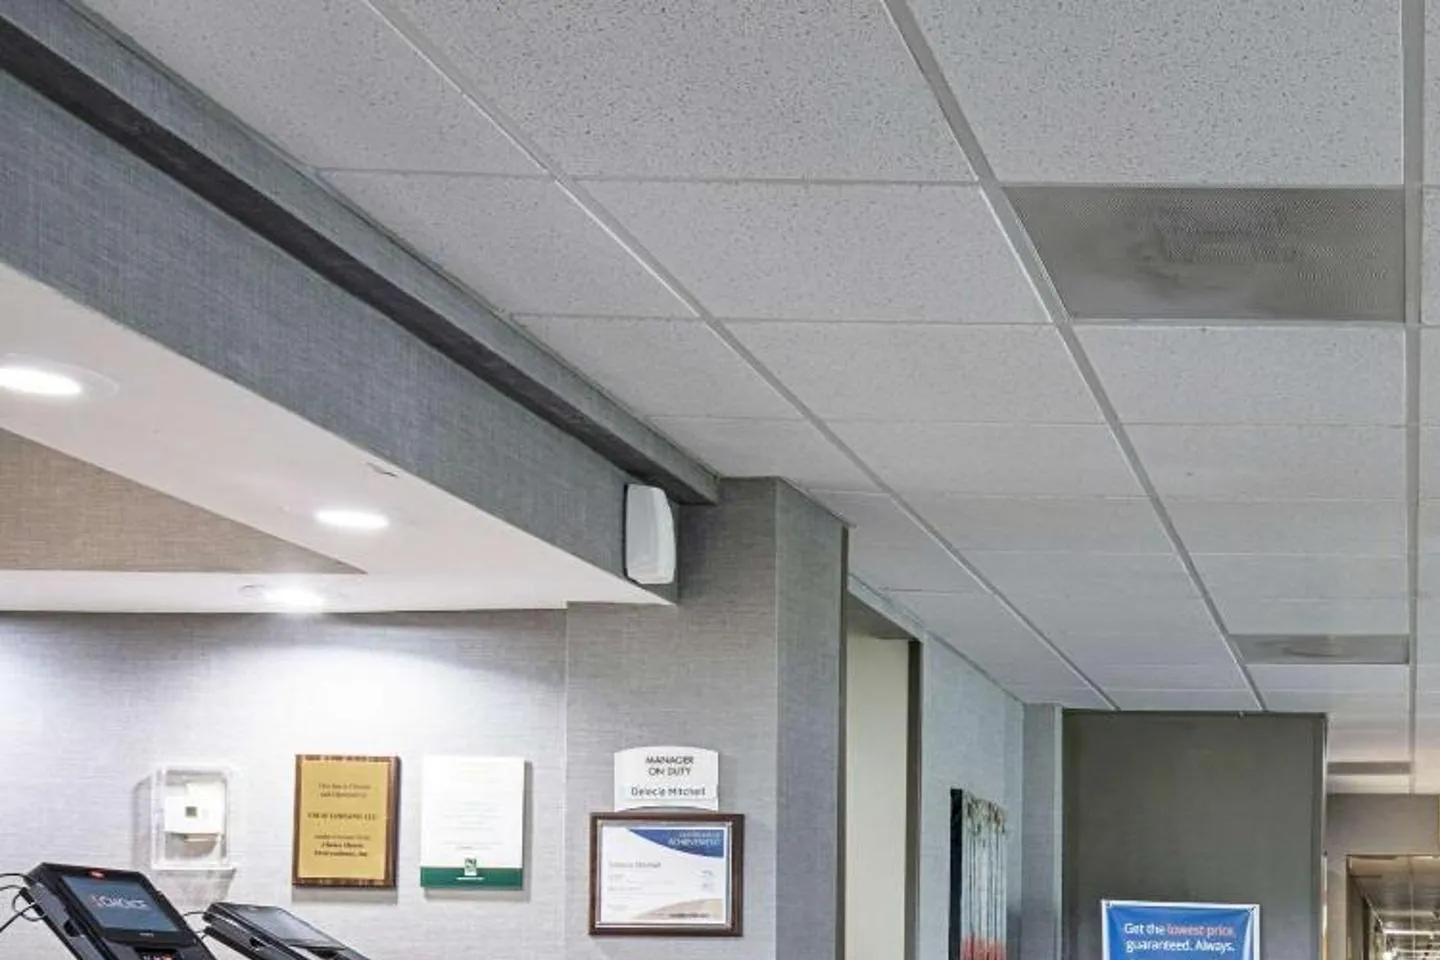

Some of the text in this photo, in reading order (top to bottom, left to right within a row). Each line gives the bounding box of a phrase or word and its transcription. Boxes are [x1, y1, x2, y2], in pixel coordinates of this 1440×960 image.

[645, 756, 695, 764] MANAGER
[648, 767, 691, 776] ON DUTY
[1124, 923, 1144, 934] Get
[1146, 923, 1165, 935] the
[1167, 924, 1205, 936] lowest
[1126, 939, 1236, 955] guaranteed. Always.
